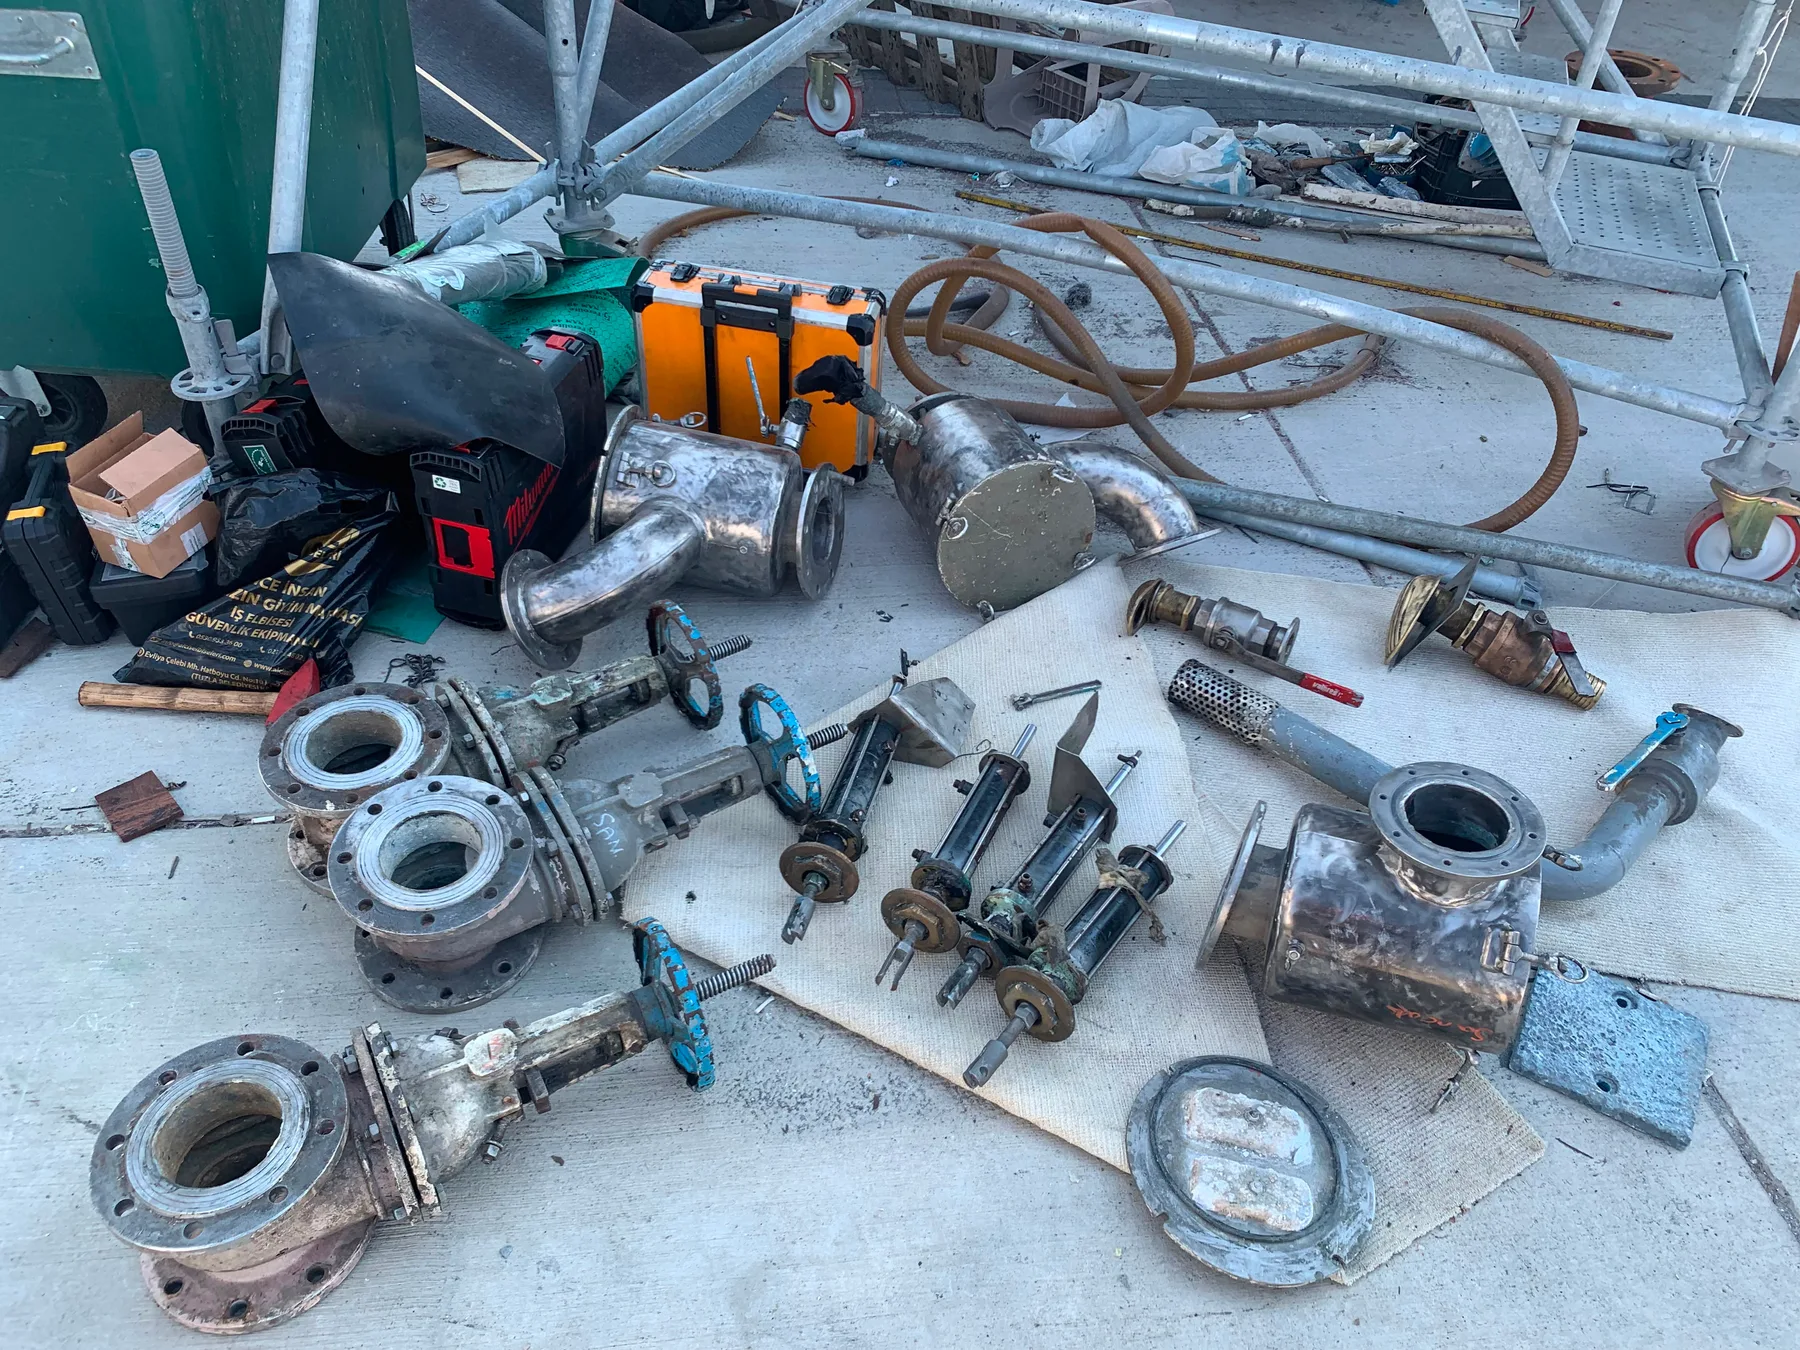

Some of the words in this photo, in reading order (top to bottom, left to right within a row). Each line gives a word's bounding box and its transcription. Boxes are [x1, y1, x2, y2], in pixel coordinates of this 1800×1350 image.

[282, 580, 328, 597] İNSAN
[263, 598, 303, 613] GİYİM
[185, 611, 252, 636] GÜVENLİK
[230, 605, 245, 622] İŞ
[245, 612, 296, 628] ELBİSESİ
[144, 650, 165, 662] Evliya
[166, 656, 186, 667] Çelebi
